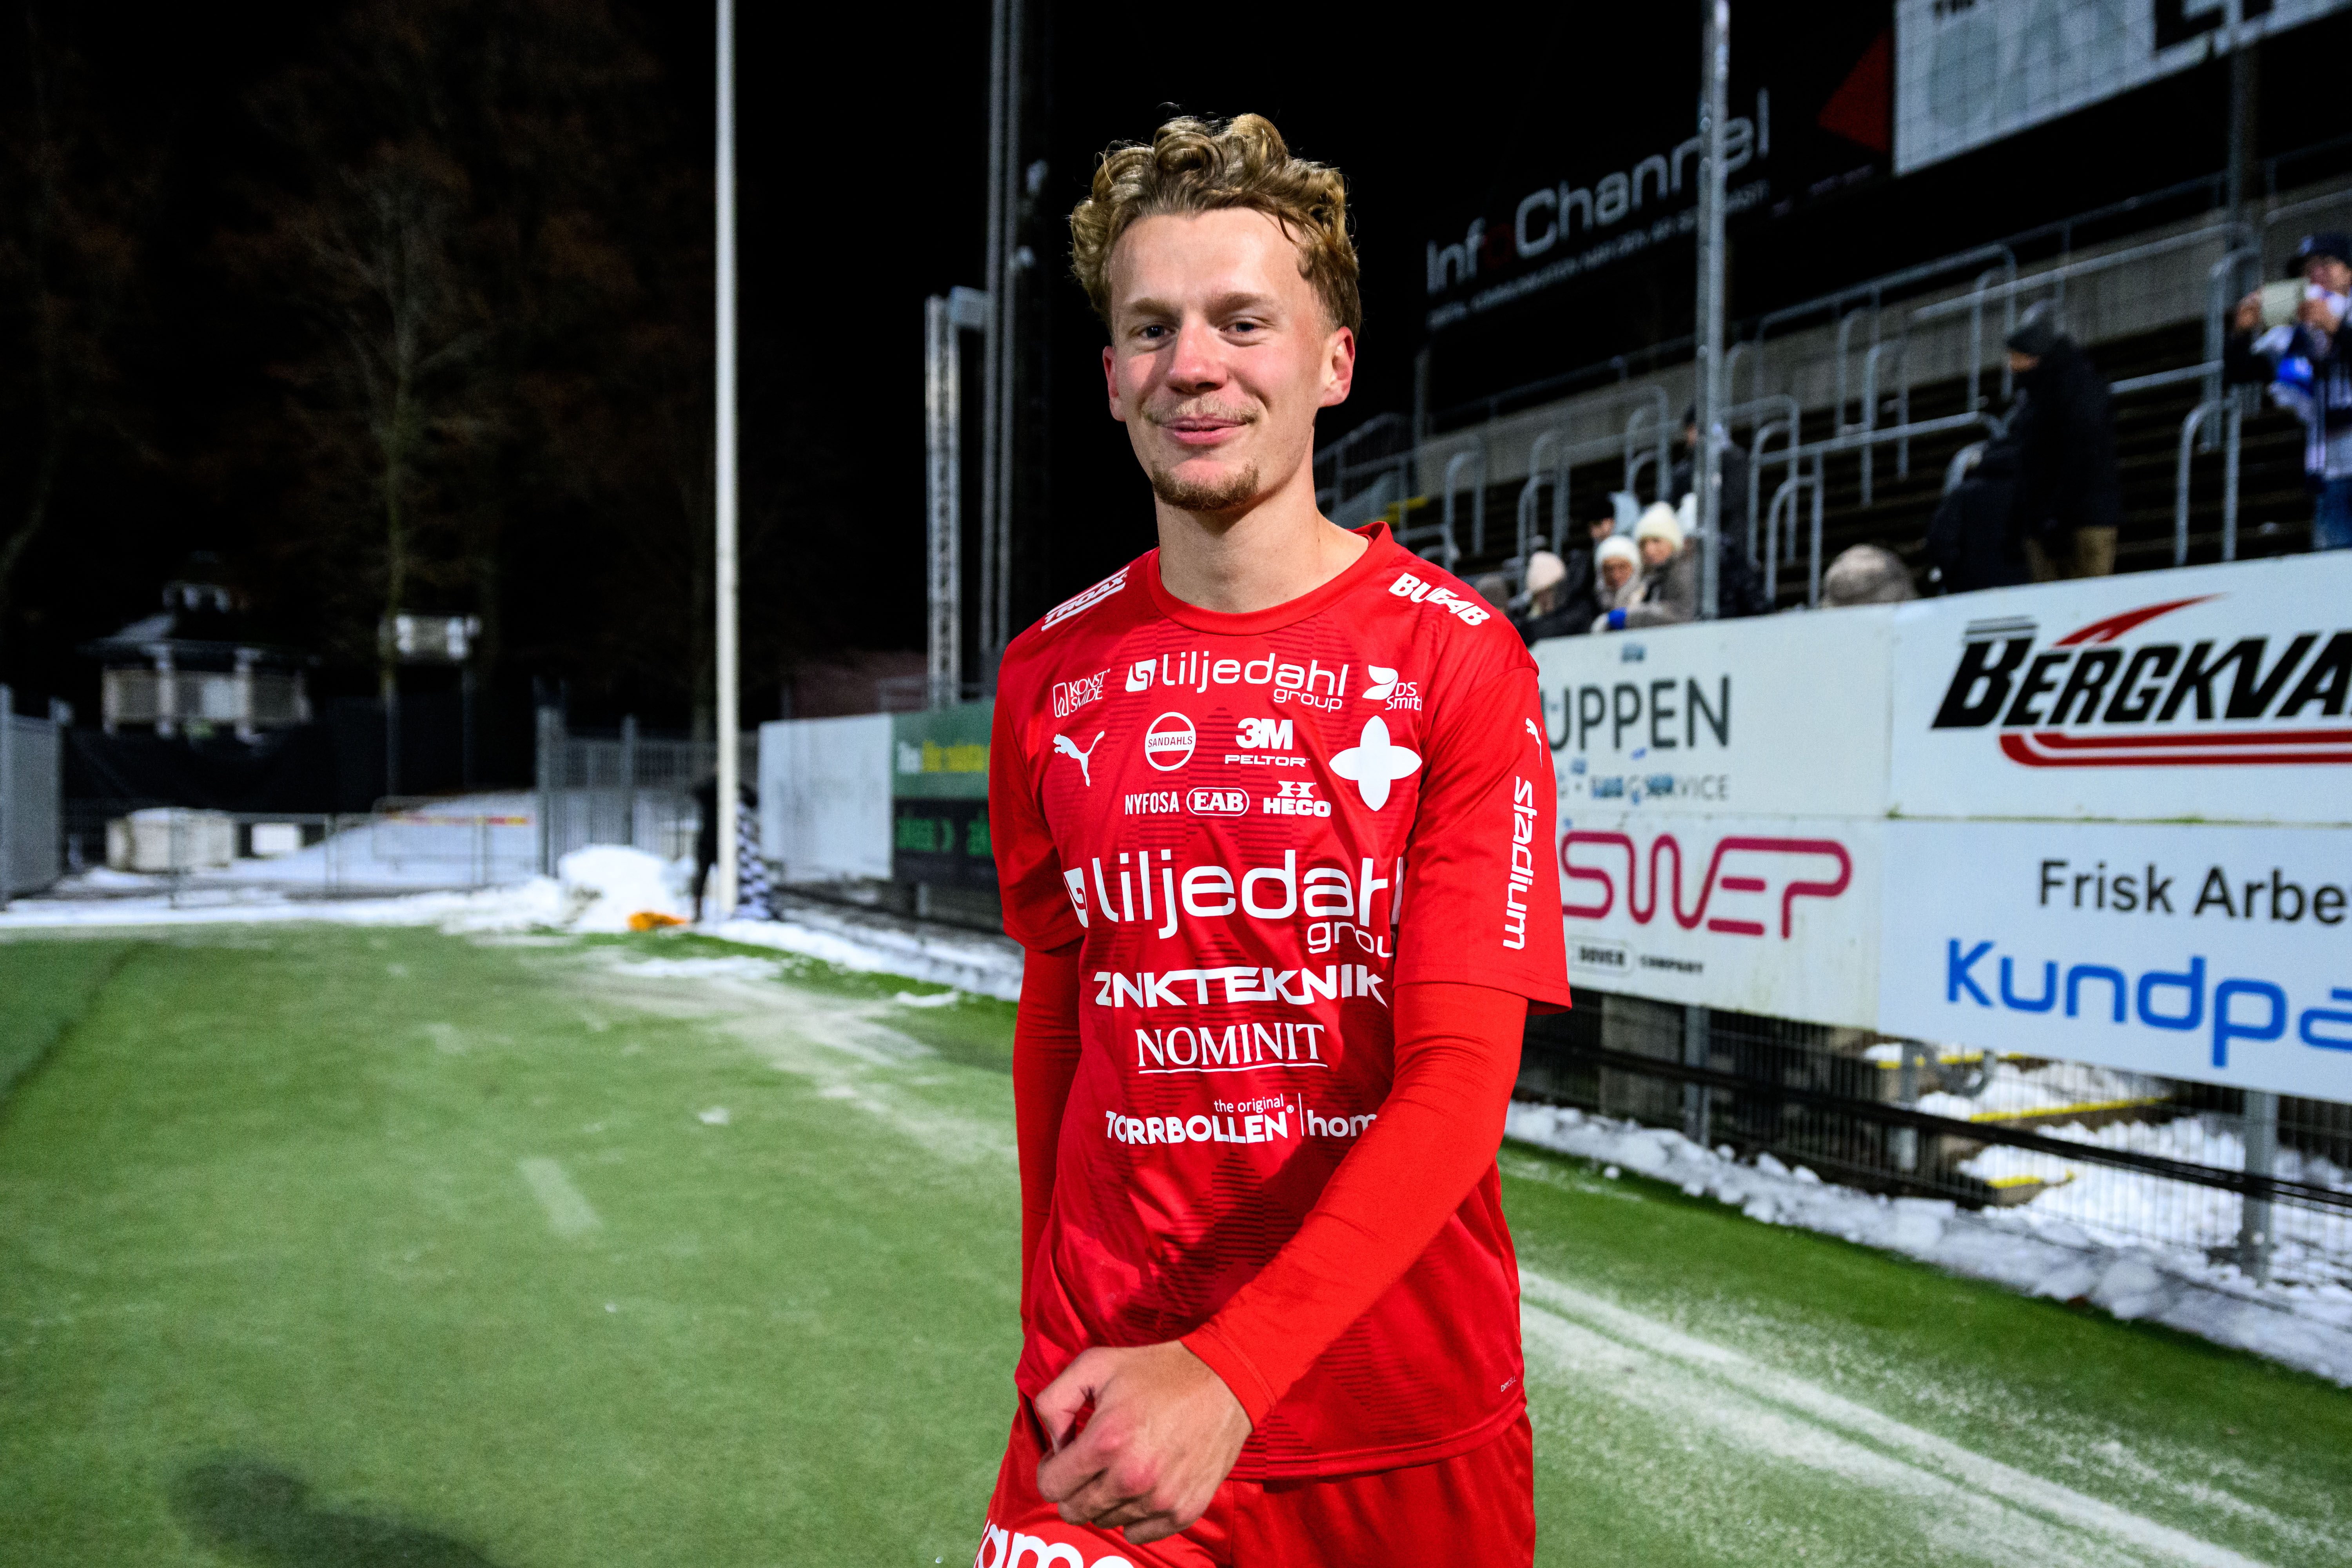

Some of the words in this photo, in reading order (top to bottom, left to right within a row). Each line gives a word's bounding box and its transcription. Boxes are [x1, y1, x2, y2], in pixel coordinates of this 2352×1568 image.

[1068, 670, 1107, 697] KONST
[1163, 651, 1349, 697] liljedahl
[1070, 684, 1103, 713] SMIDE
[1273, 688, 1343, 713] group
[1395, 682, 1417, 697] DS
[1148, 736, 1192, 748] SANDAHLS
[1236, 717, 1293, 750] 3M
[1125, 791, 1180, 815] NYFOSA
[1193, 792, 1244, 811] EAB
[1263, 797, 1331, 817] HECO
[1503, 776, 1537, 950] stadium
[1560, 829, 1854, 939] SWEP
[2039, 860, 2174, 914] Frisk
[1135, 1022, 1325, 1067] NOMINIT
[1214, 1099, 1234, 1113] the
[1238, 1094, 1285, 1113] original
